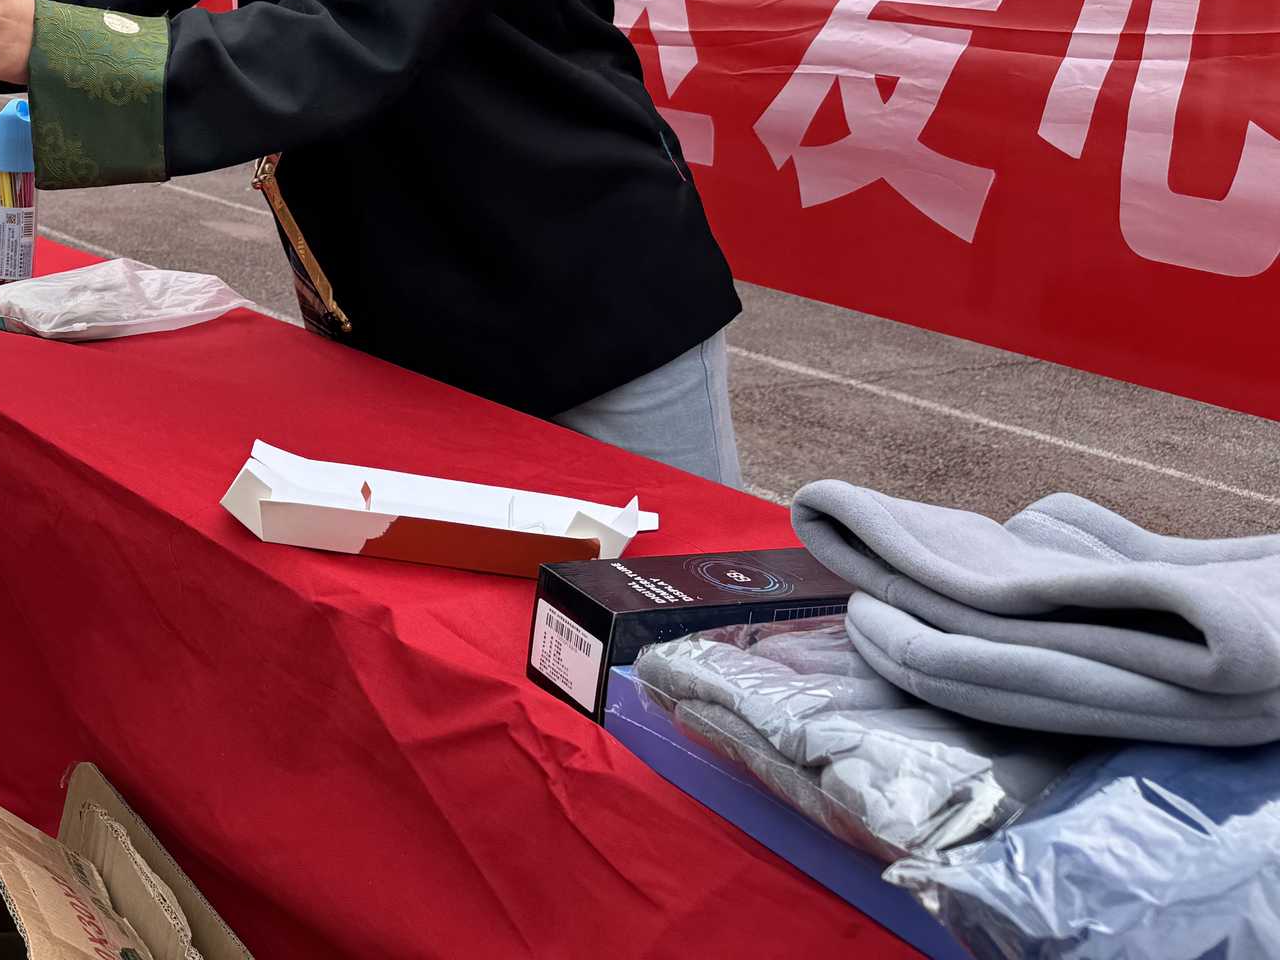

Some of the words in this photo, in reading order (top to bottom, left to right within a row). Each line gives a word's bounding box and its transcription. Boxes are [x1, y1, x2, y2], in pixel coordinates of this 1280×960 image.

[611, 562, 679, 603] TEMPERATURE
[627, 581, 666, 604] DIGITAL
[650, 577, 694, 602] DISPLAY
